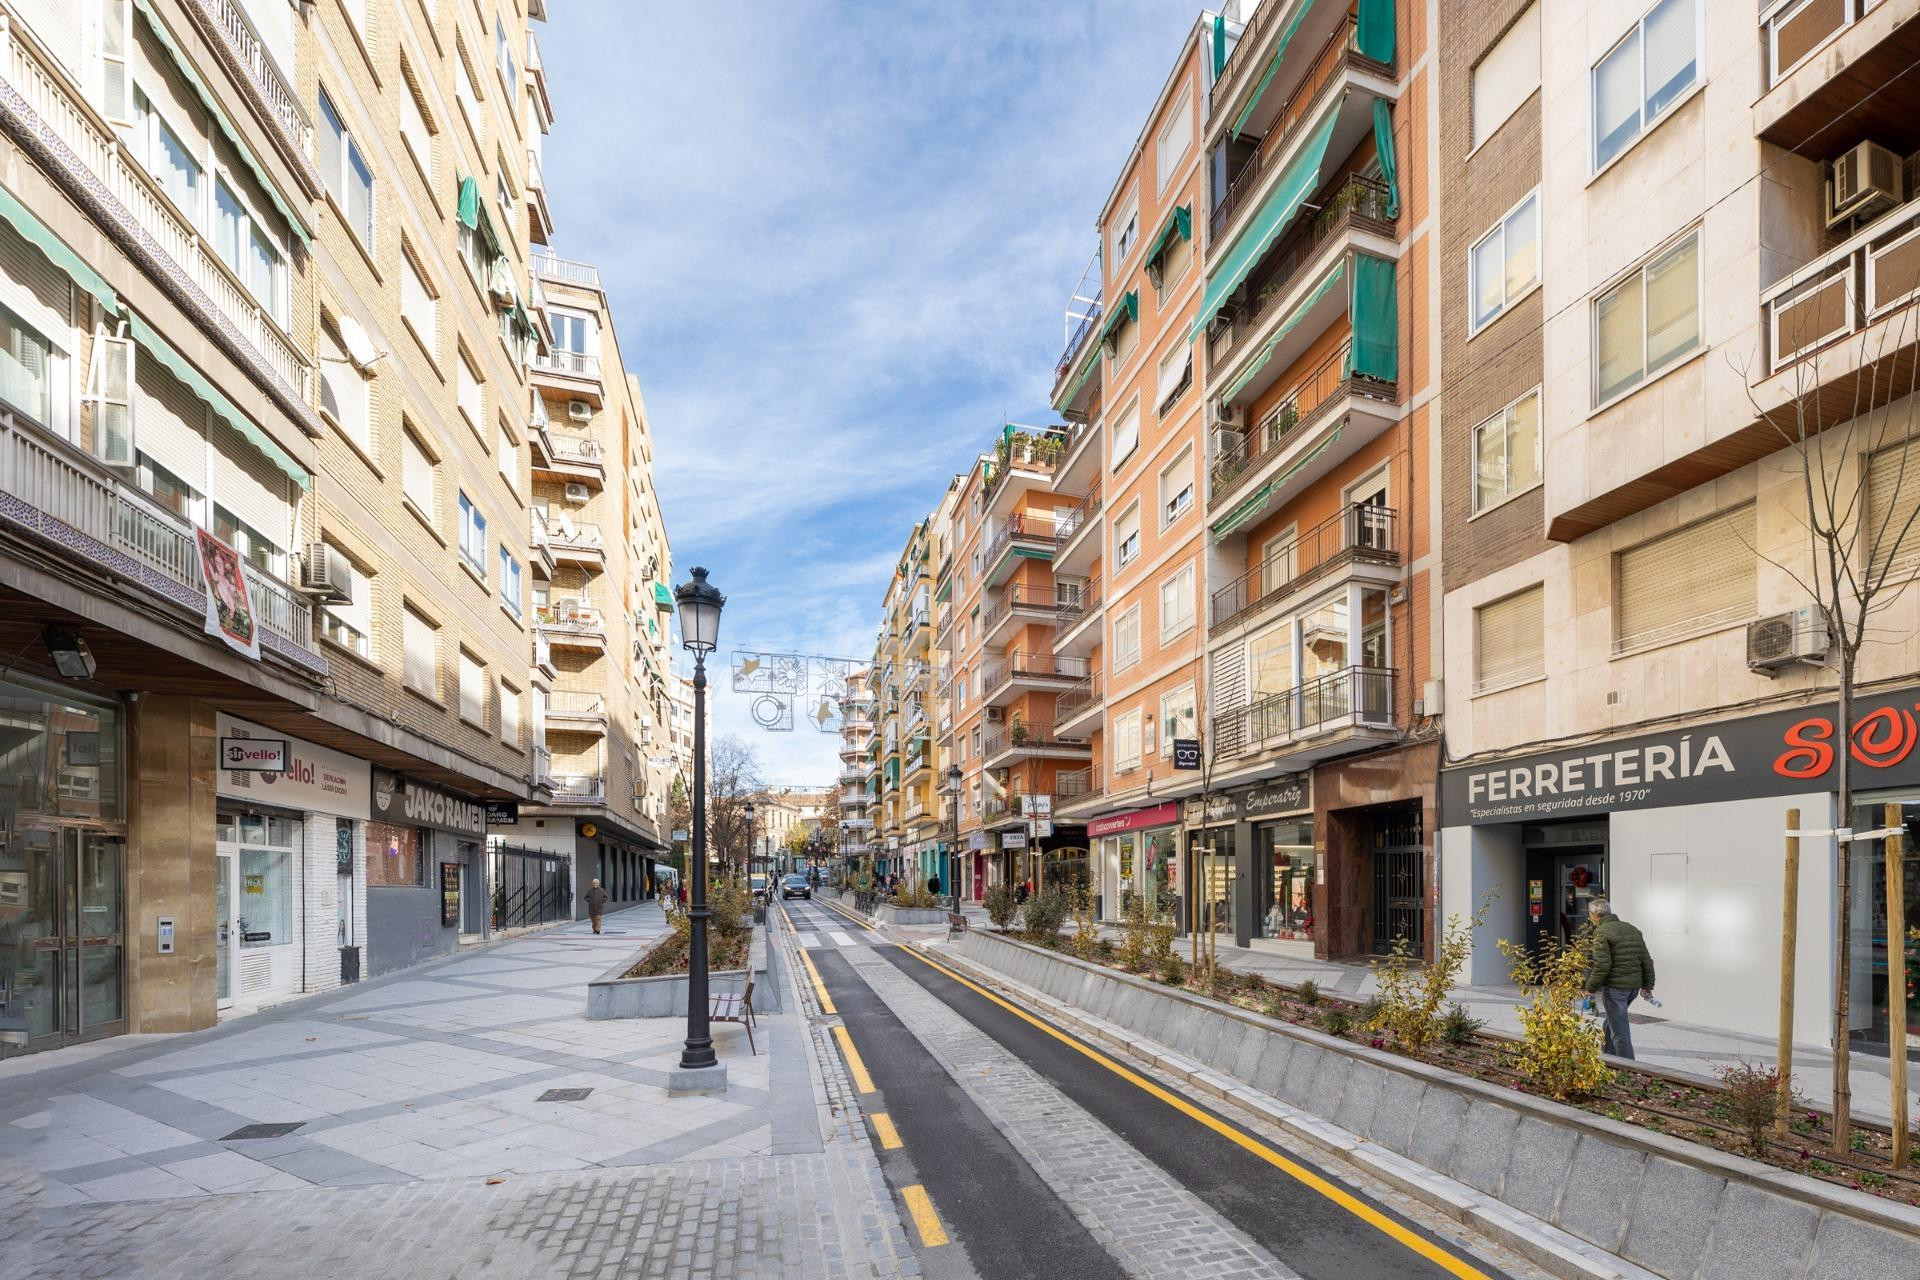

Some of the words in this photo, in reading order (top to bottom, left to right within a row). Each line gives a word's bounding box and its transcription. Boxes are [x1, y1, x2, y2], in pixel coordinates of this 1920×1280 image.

[1773, 703, 1920, 778] SO
[1469, 734, 1736, 804] FERRETERÍA
[404, 783, 444, 824] JAKO
[445, 797, 486, 834] RAMEN
[1245, 785, 1302, 811] Emperatriz
[1524, 804, 1535, 812] en
[1537, 796, 1583, 813] seguridad
[1585, 793, 1615, 807] desde
